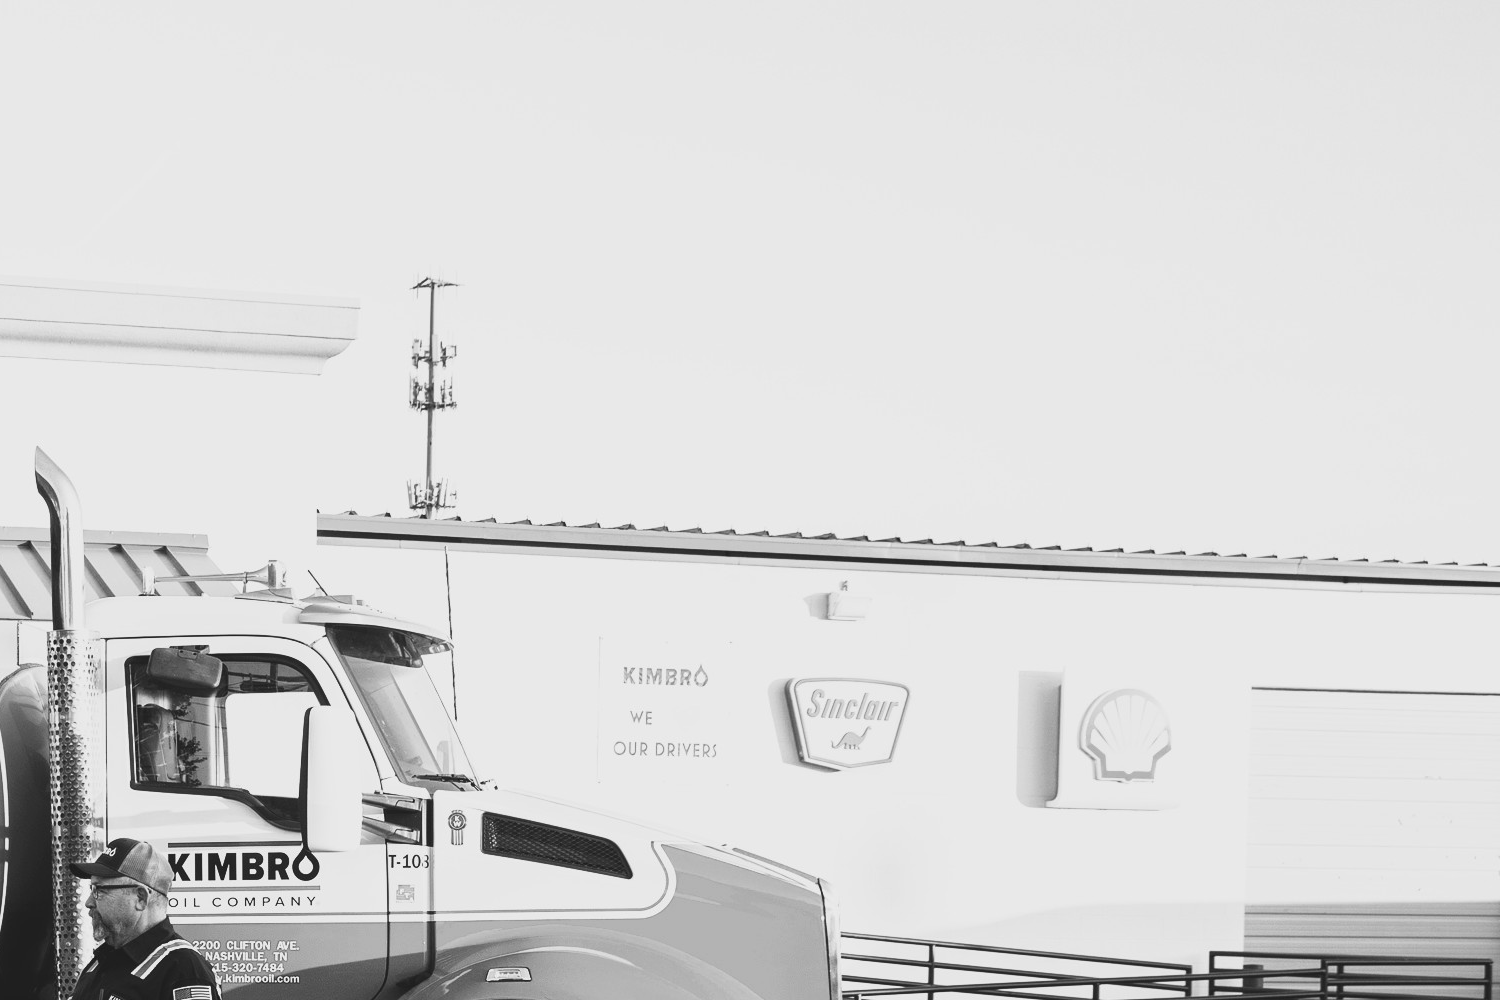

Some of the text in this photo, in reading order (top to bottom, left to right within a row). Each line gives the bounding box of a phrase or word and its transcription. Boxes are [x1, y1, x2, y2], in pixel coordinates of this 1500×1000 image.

[622, 664, 709, 688] KIMBRO
[806, 688, 900, 722] Sinclair
[629, 710, 653, 725] WE
[613, 741, 717, 758] OUR DRIVERS
[167, 848, 320, 882] KIMBRO
[168, 896, 316, 908] OIL COMPANY
[192, 940, 300, 951] 2200 CLIFTON AVE.
[205, 952, 288, 962] NASHVILLE, TN
